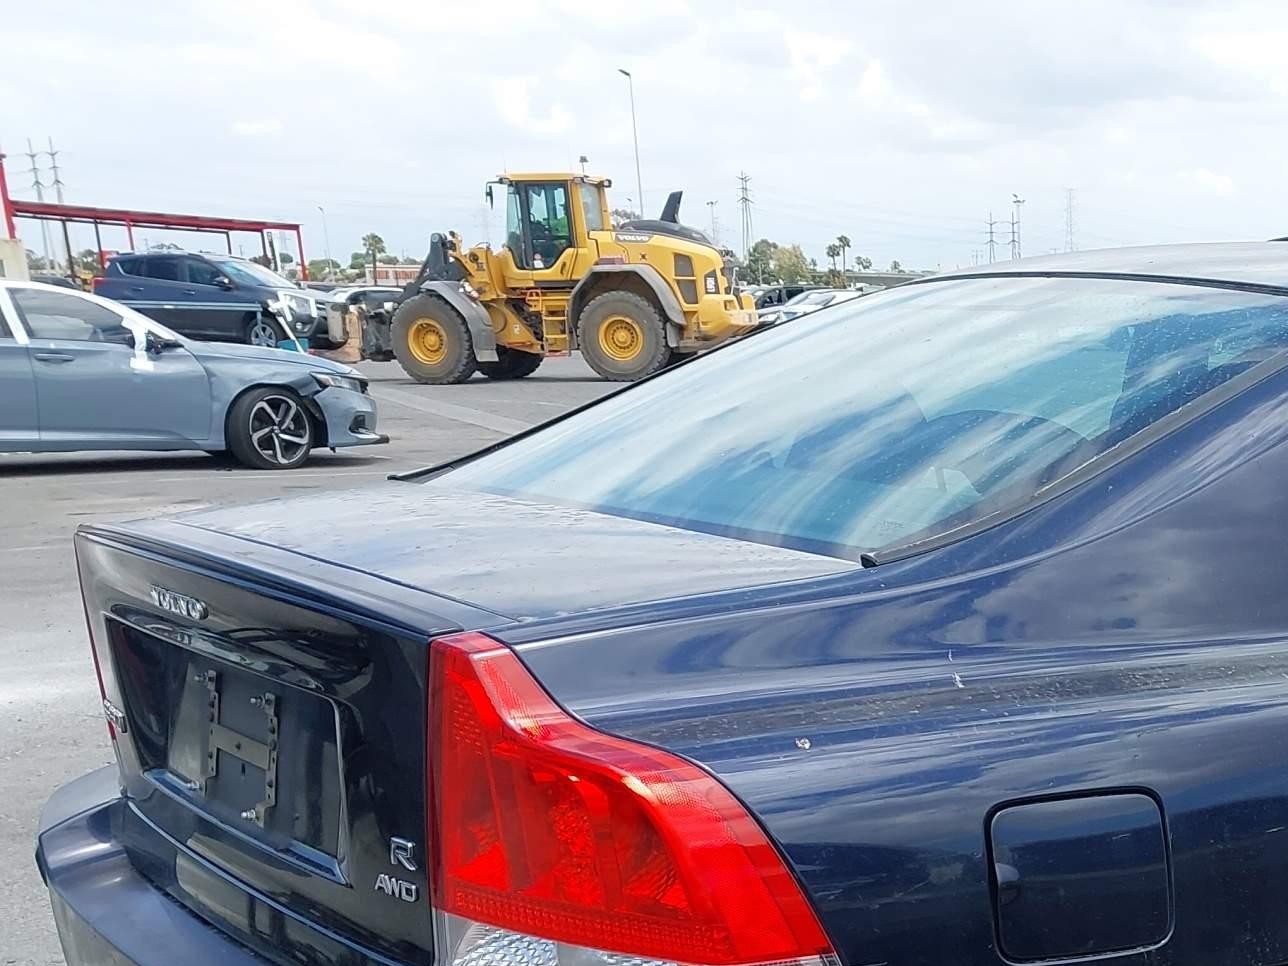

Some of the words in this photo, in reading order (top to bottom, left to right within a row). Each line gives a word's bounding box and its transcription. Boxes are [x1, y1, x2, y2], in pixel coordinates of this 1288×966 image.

[150, 584, 207, 620] VOLVO
[390, 836, 418, 871] R
[374, 873, 418, 903] AWD
